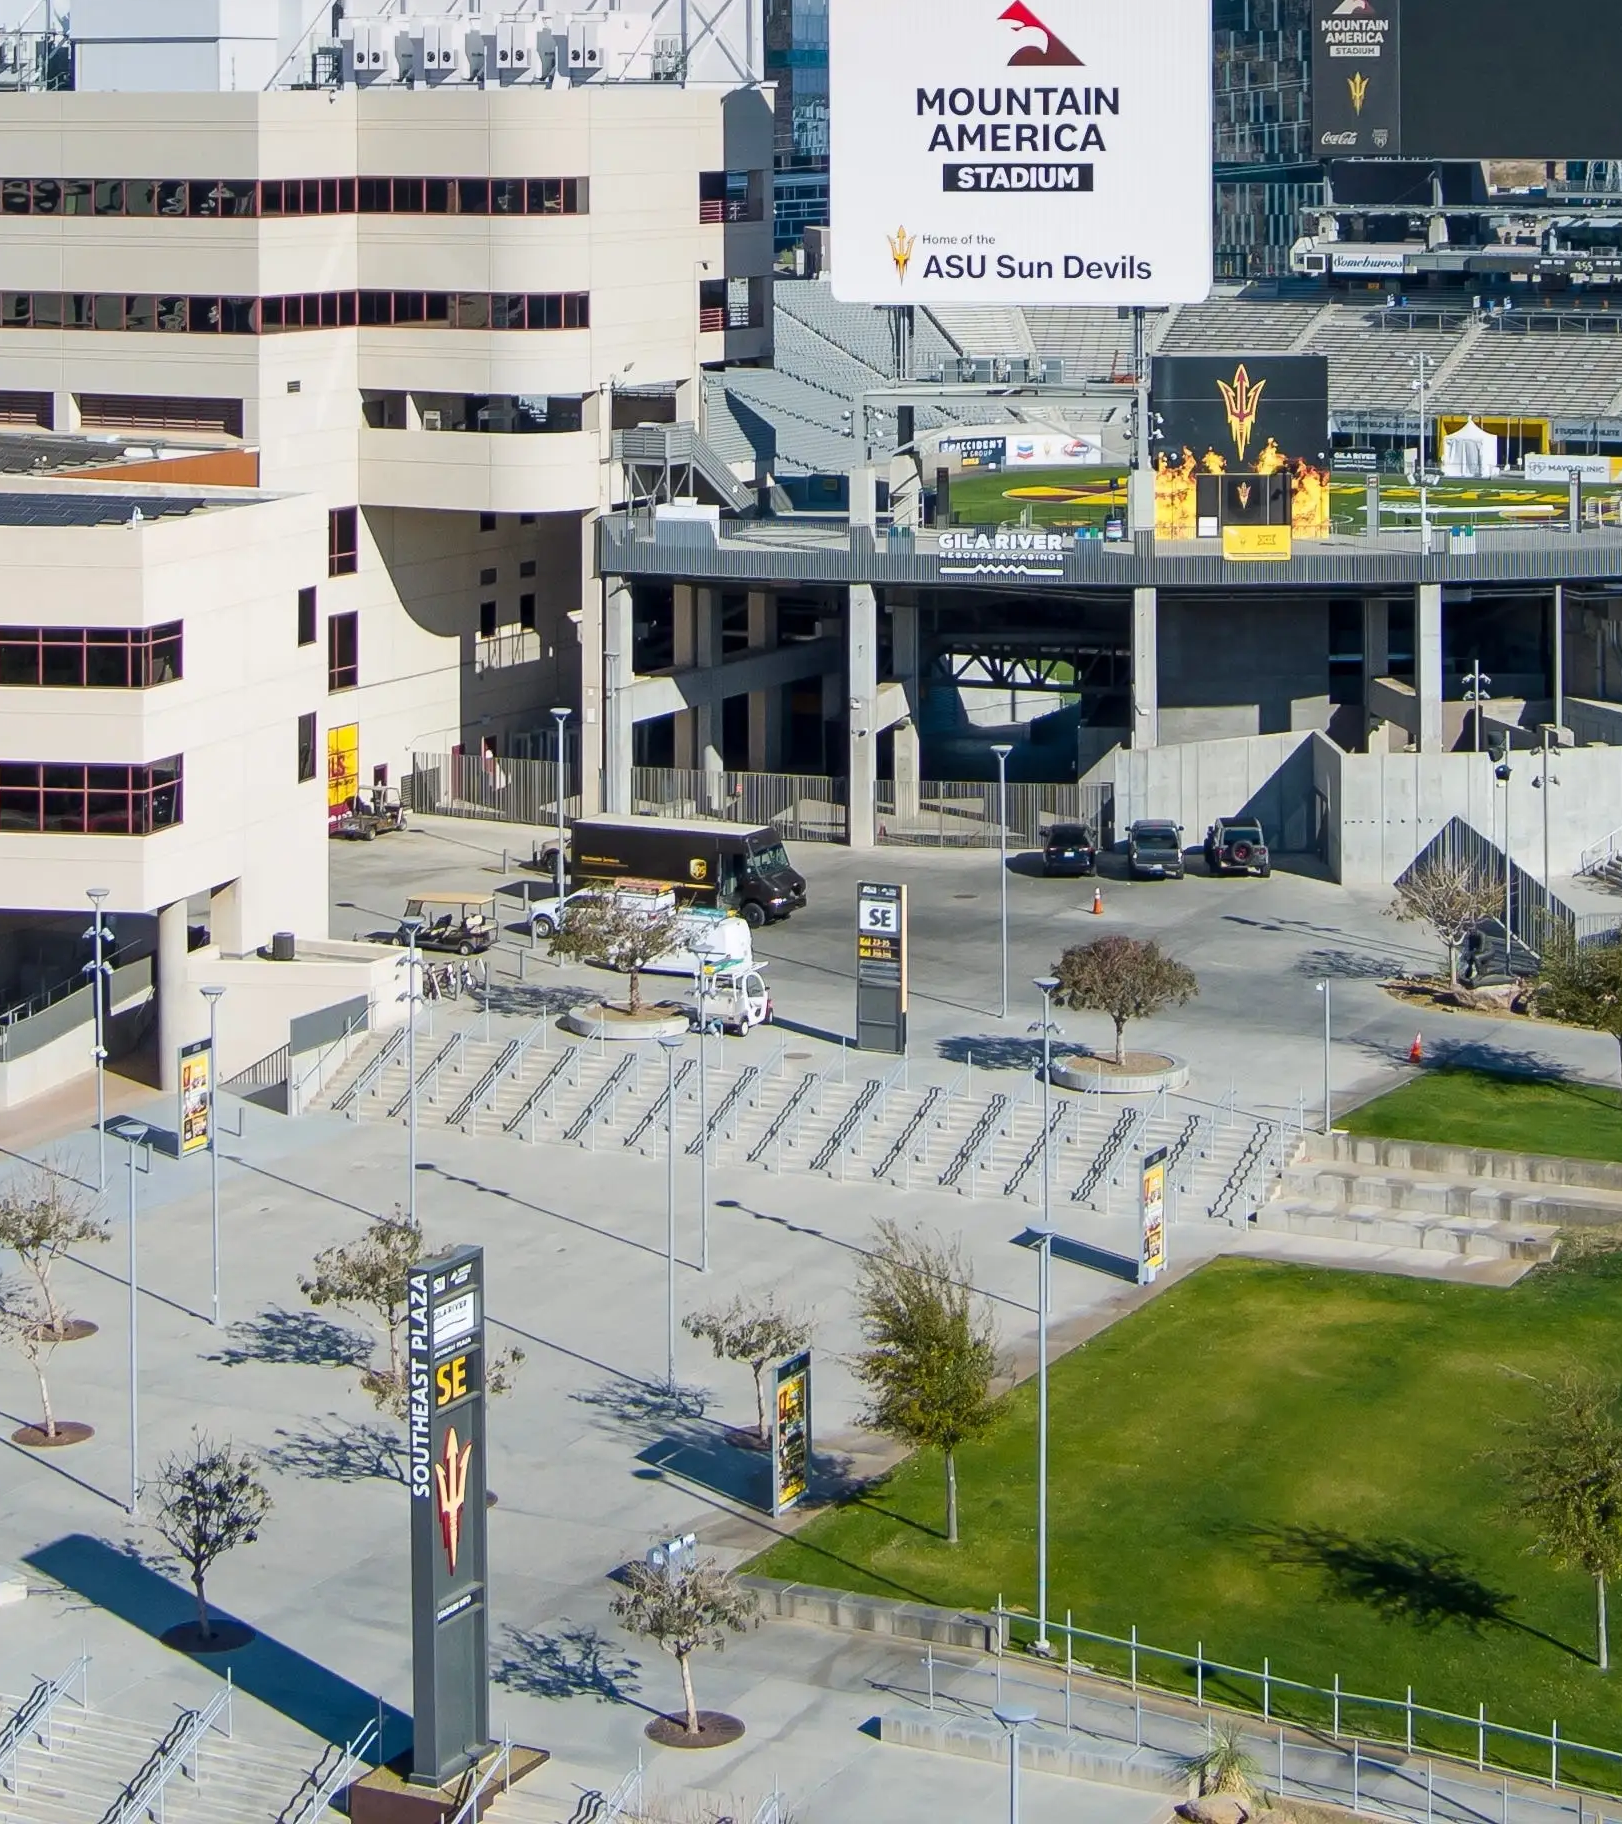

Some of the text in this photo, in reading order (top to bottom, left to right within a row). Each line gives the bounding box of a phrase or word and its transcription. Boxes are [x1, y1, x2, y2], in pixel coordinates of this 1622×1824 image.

[1321, 19, 1389, 31] MOUNTAIN
[1325, 32, 1384, 44] AMERICA
[1335, 46, 1375, 55] STADIUM
[916, 87, 1120, 116] MOUNTAIN
[927, 123, 1107, 152] AMERICA
[957, 166, 1079, 189] STADIUM
[922, 234, 996, 245] Home of the
[922, 254, 1152, 280] ASU Sun Devils
[1333, 255, 1403, 268] Someburros
[1554, 427, 1588, 437] STUDENT
[955, 439, 1004, 452] ACCIDENT
[969, 449, 993, 457] GROUP
[1548, 464, 1605, 474] MAYO CLINIC
[939, 533, 1063, 550] GILA RIVER
[939, 551, 994, 560] RESORTS
[1011, 553, 1064, 561] CASINOS
[868, 908, 891, 928] SE
[447, 1299, 467, 1313] RIVER
[410, 1273, 430, 1499] SOUTHEAST PLAZA
[436, 1355, 467, 1407] SE
